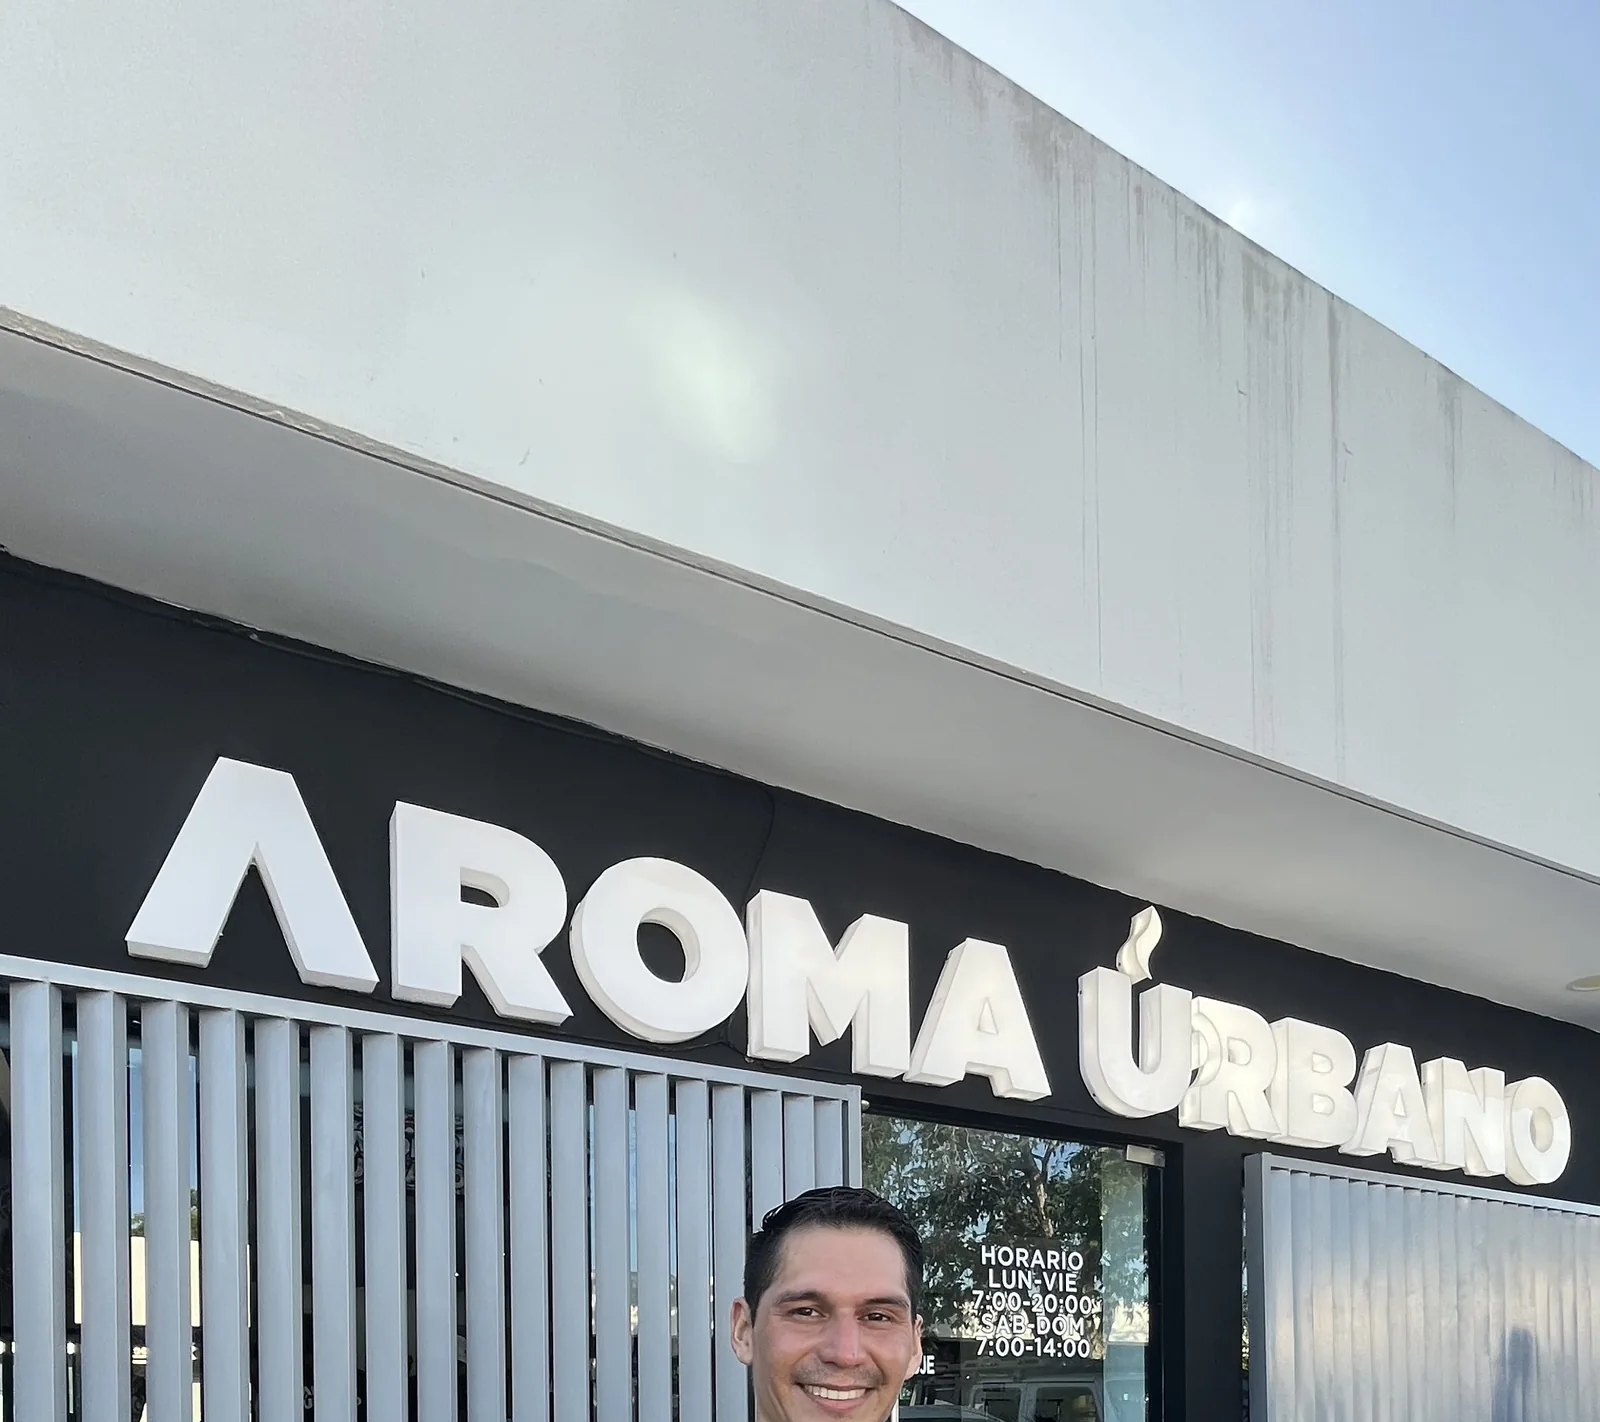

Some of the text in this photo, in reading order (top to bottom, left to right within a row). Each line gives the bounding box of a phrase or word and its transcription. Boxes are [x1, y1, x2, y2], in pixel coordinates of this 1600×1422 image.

[126, 756, 1052, 1102] AROMA
[981, 1245, 1084, 1271] HORARIO
[988, 1268, 1078, 1293] LUN-VIE
[971, 1290, 1093, 1316] 7:00-20:00
[981, 1314, 1085, 1337] SAB-DOM
[975, 1336, 1091, 1358] 7:00-14:00
